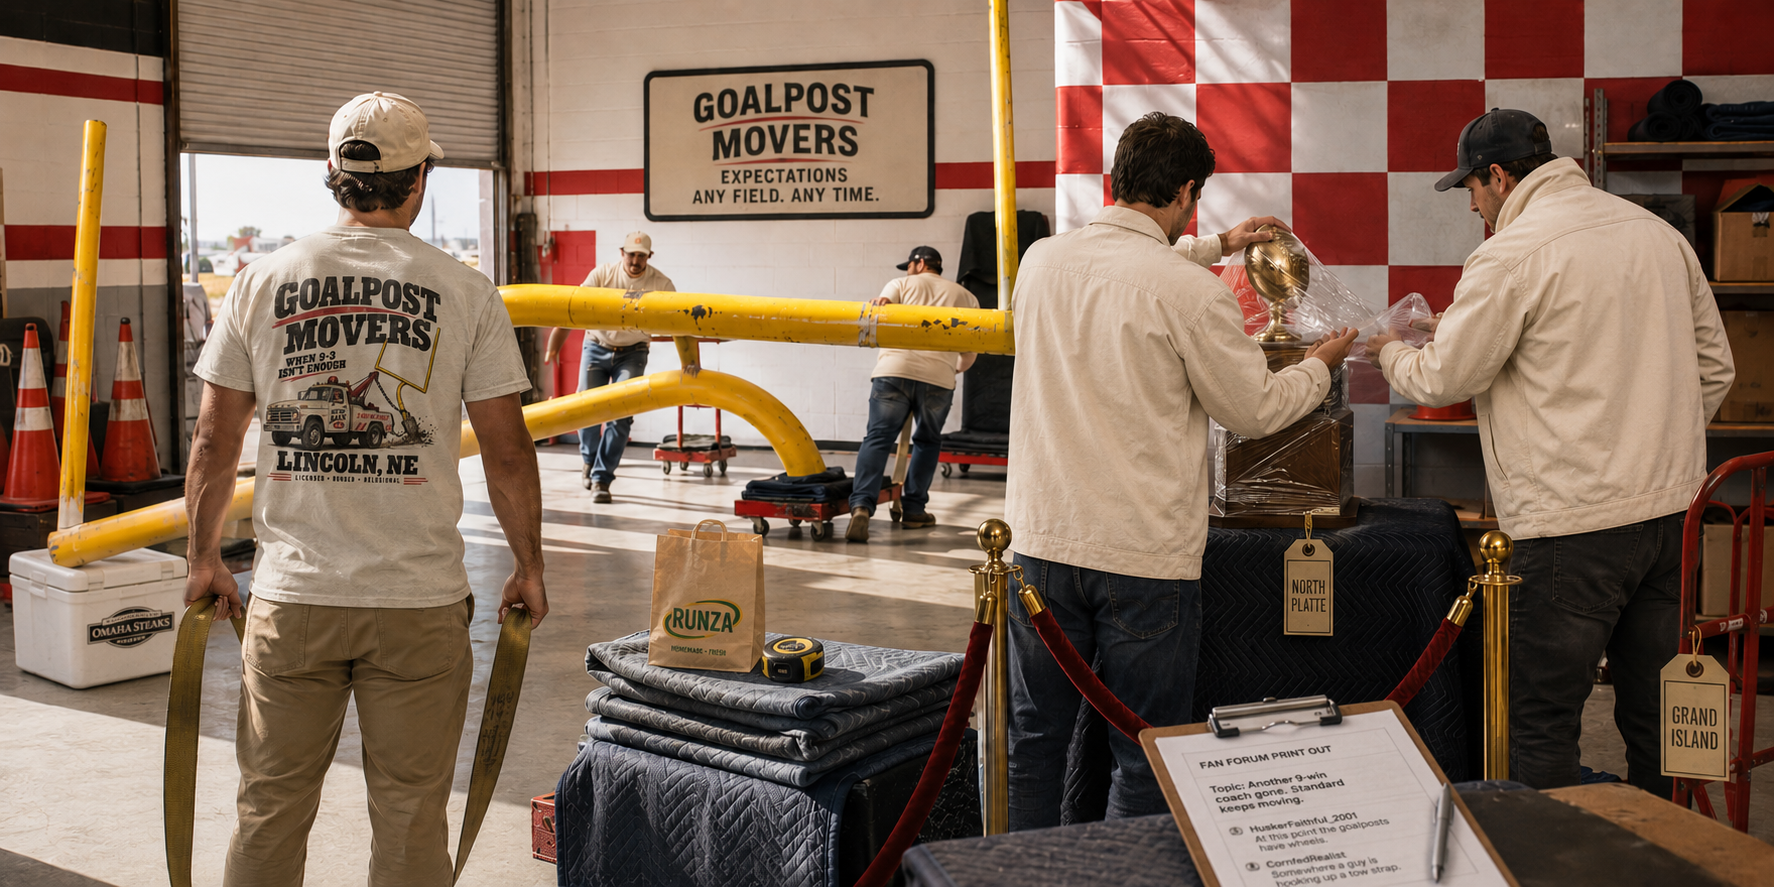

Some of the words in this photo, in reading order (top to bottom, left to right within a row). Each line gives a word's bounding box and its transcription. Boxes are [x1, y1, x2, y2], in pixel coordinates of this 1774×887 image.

[694, 82, 875, 123] GOALPOST
[712, 124, 859, 161] MOVERS
[721, 168, 848, 184] EXPECTATIONS
[692, 190, 726, 204] ANY
[733, 188, 784, 203] FIELD.
[791, 188, 826, 203] ANY
[832, 187, 879, 202] TIME.
[274, 276, 441, 323] GOALPOST
[283, 313, 431, 355] MOVERS
[286, 353, 316, 367] WHEN
[319, 351, 336, 362] 9-3
[307, 360, 346, 373] ENOUGH
[277, 450, 383, 476] LINCOLN,
[386, 454, 419, 475] NE
[1292, 579, 1325, 594] NORTH
[1291, 597, 1326, 612] PLATTE
[92, 624, 132, 639] OMAHA
[133, 617, 170, 632] STEAKS
[672, 607, 734, 633] RUNZA
[1672, 705, 1717, 727] GRAND
[1671, 728, 1718, 750] ISLAND
[1199, 759, 1224, 769] FAN
[1226, 753, 1270, 766] FORUM
[1271, 749, 1305, 760] PRINT
[1307, 745, 1332, 755] OUT
[1209, 783, 1246, 794] Topic:
[1248, 776, 1293, 789] Another
[1294, 771, 1328, 782] 9-win
[1215, 792, 1252, 804] coach
[1254, 788, 1288, 800] gone.
[1290, 779, 1345, 793] Standard
[1218, 803, 1256, 814] keeps
[1258, 796, 1304, 809] moving.
[1249, 811, 1358, 834] HuskerFaithful_2001
[1255, 835, 1267, 843] At
[1269, 832, 1289, 841] this
[1291, 828, 1318, 840] point
[1319, 825, 1337, 834] the
[1338, 817, 1390, 833] goalposts
[1259, 843, 1286, 852] have
[1288, 837, 1329, 848] wheels.
[1265, 851, 1347, 868] CornfedRealist
[1271, 863, 1336, 879] Somewhere
[1347, 859, 1366, 869] guy
[1367, 856, 1378, 865] is
[1275, 875, 1322, 887] hooking
[1322, 873, 1338, 882] up
[1348, 869, 1368, 877] tow
[1370, 864, 1402, 875] strap.
